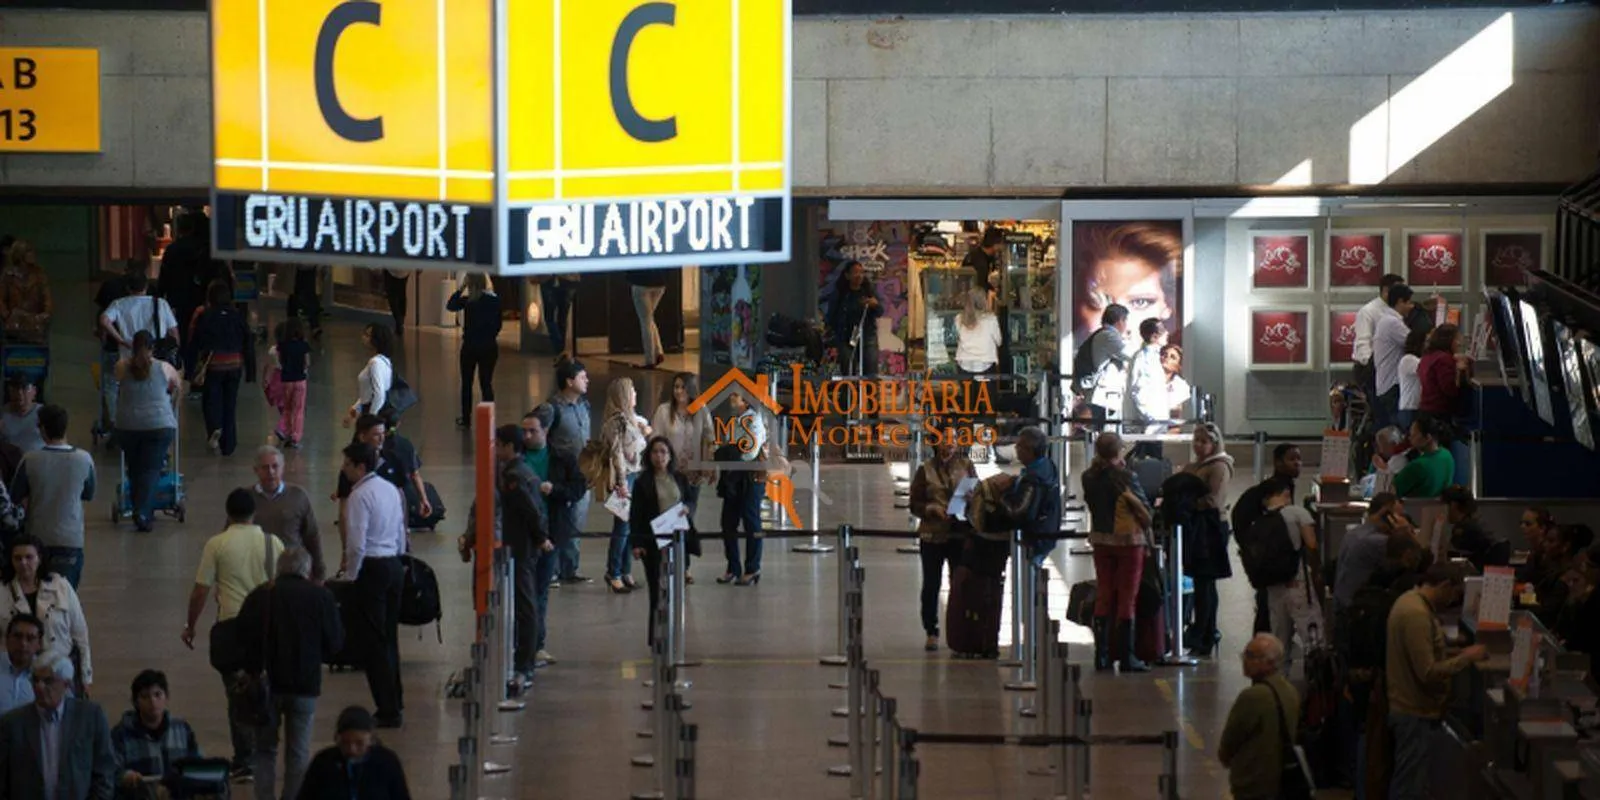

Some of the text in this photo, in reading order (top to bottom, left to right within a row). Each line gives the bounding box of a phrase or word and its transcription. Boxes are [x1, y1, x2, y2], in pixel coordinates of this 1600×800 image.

[14, 57, 37, 89] B
[314, 0, 384, 142] C
[609, 2, 678, 142] C
[0, 109, 37, 141] 13
[245, 194, 470, 258] GRU AIRPORT
[527, 197, 754, 259] GRU AIRPORT
